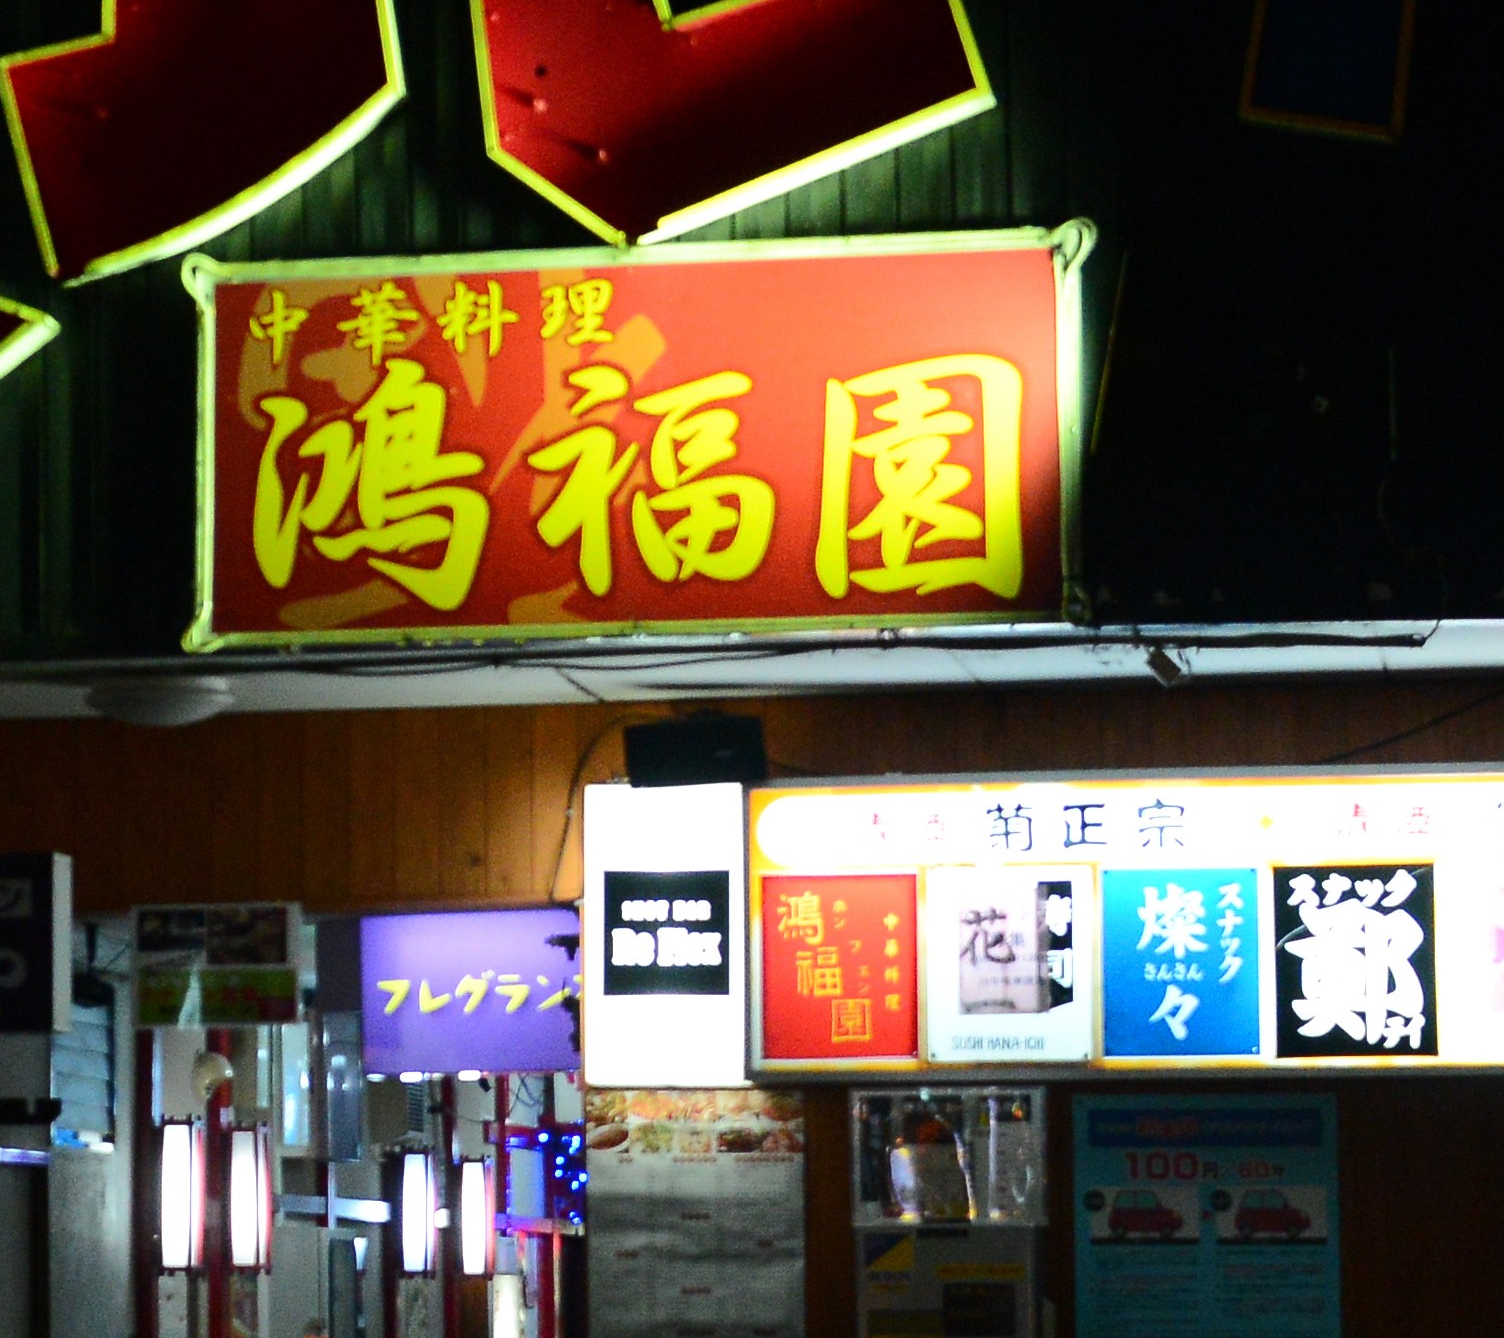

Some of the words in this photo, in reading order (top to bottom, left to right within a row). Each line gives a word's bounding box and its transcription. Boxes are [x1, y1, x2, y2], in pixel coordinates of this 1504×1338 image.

[248, 277, 615, 364] 中華料理
[253, 353, 1023, 611] 鴻福園
[986, 798, 1185, 852] 菊正宗
[1287, 869, 1418, 907] スナック
[776, 890, 872, 1043] 鴻福園
[1216, 882, 1244, 985] スナック
[377, 969, 583, 1015] フレグラン
